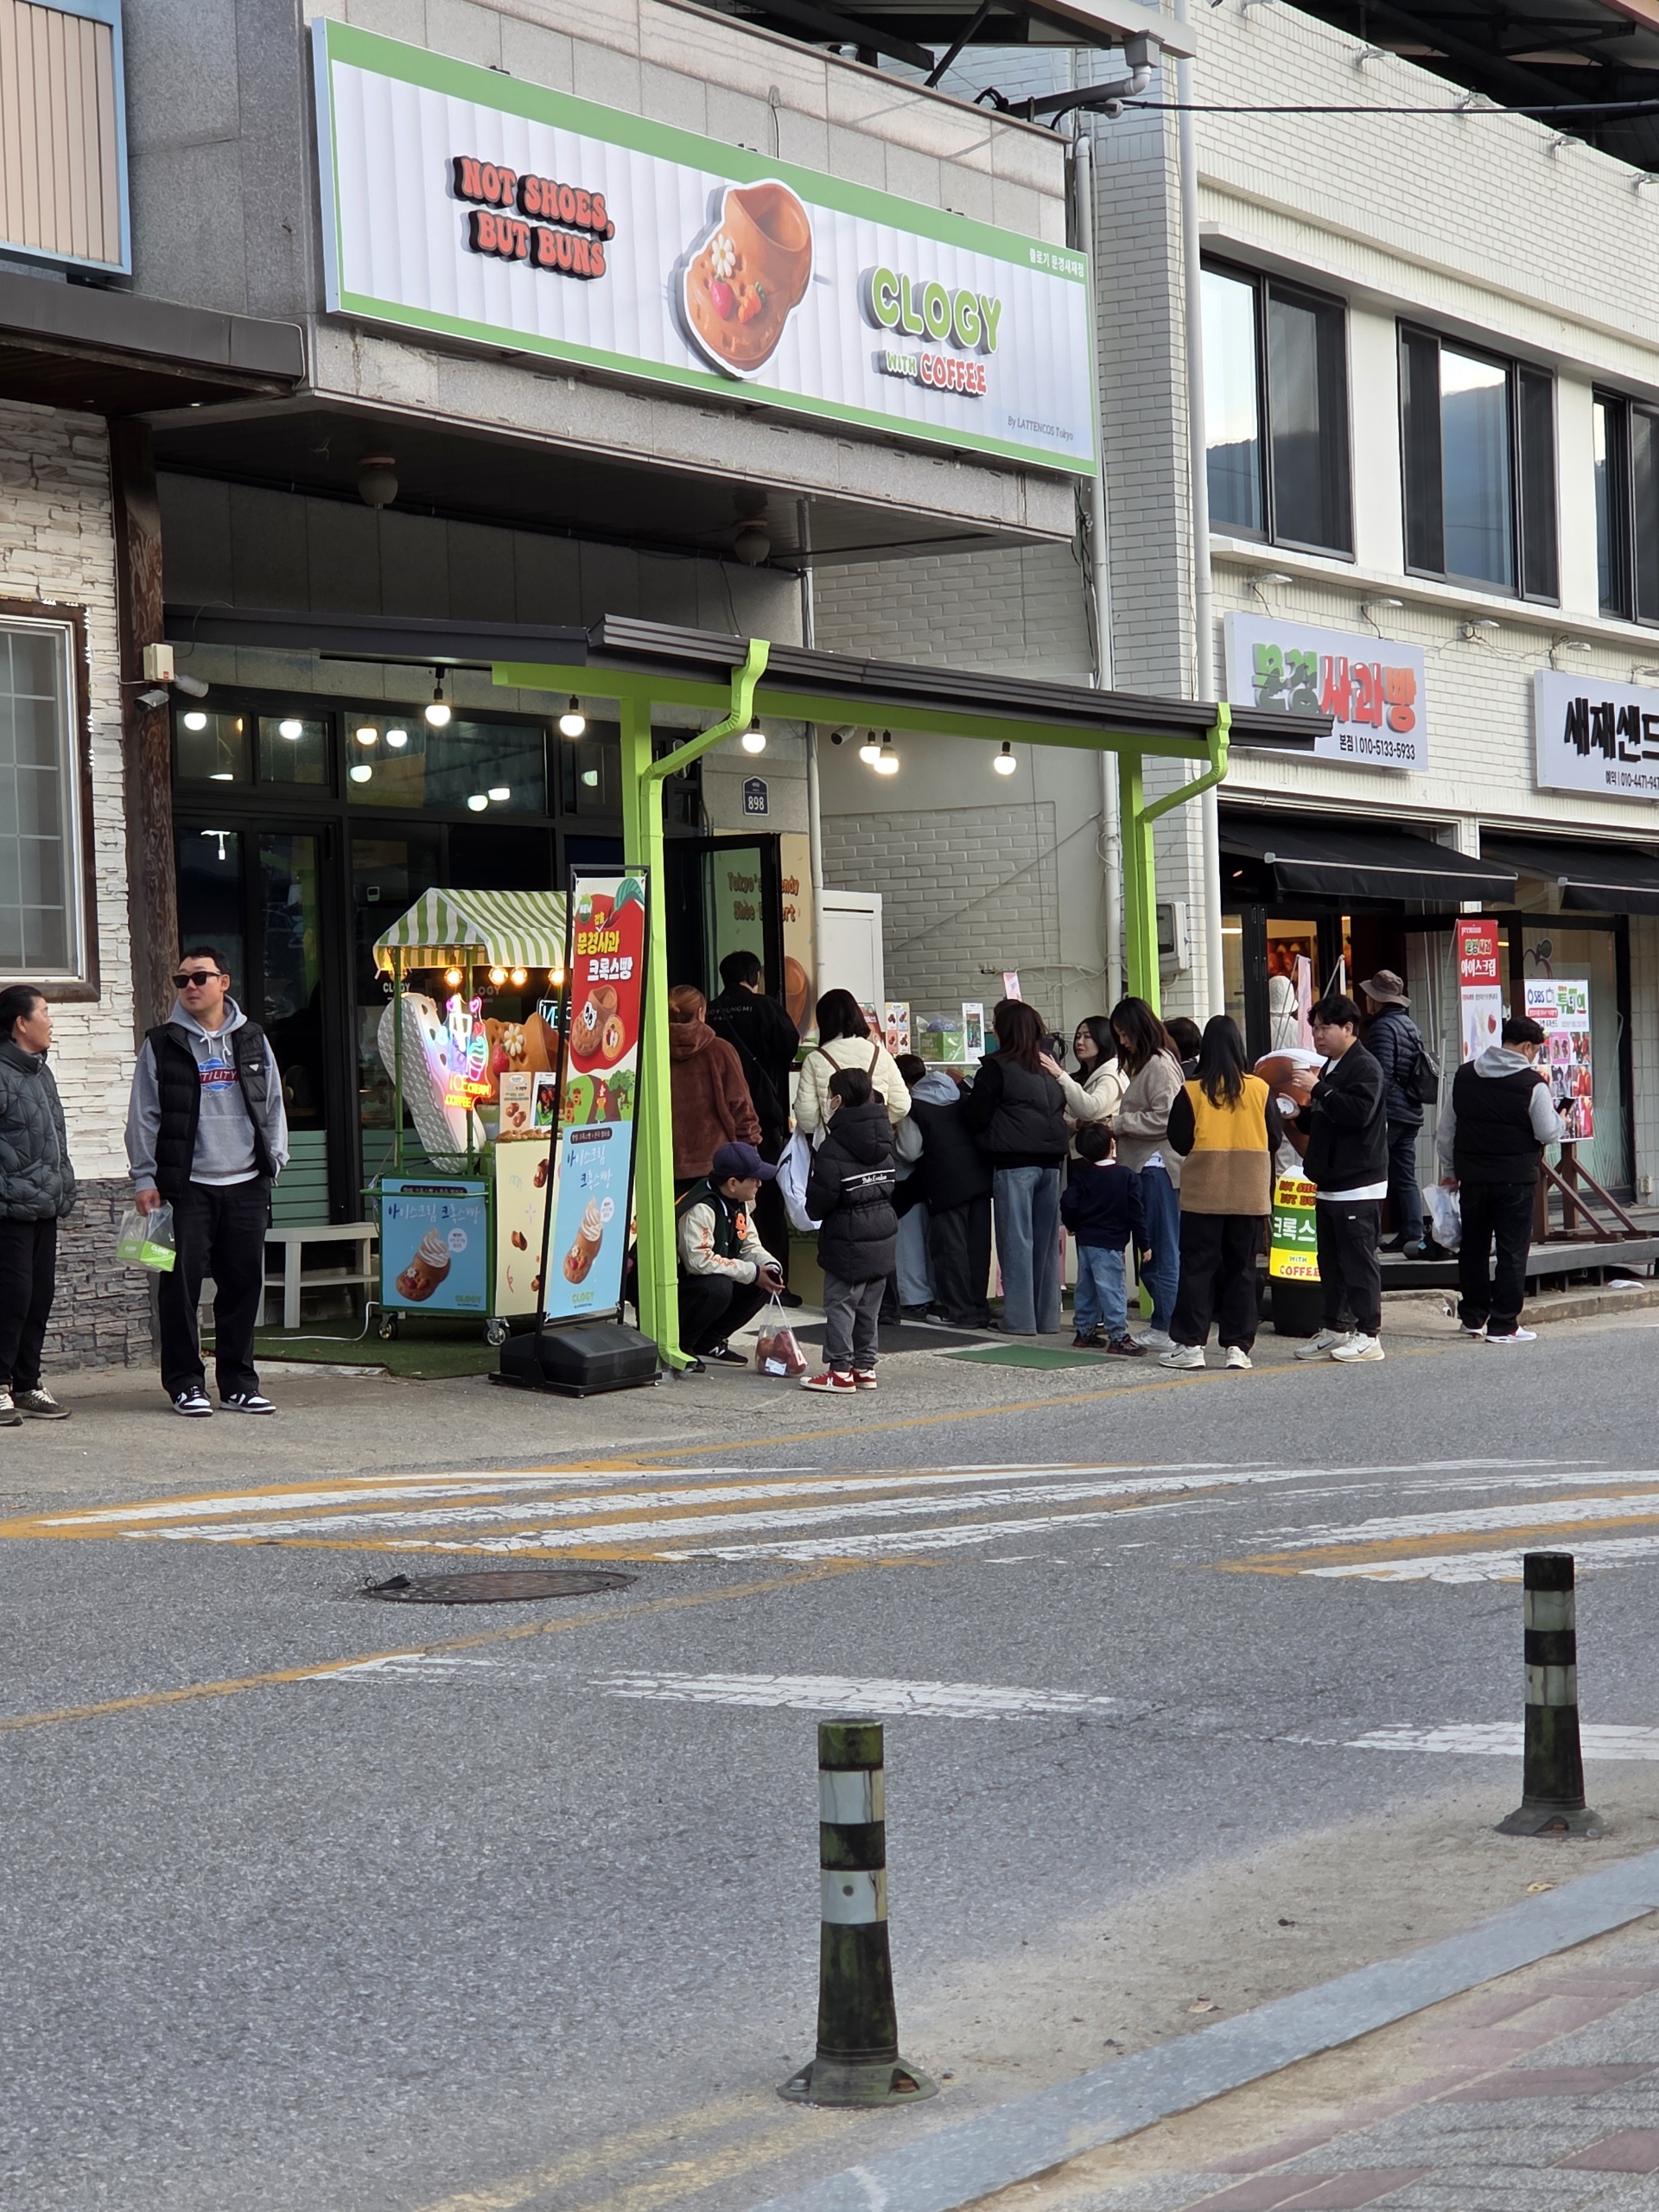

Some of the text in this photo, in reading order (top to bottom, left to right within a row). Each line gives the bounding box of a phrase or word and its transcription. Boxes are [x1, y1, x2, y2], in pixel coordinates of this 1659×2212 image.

[455, 156, 615, 240] NOT SHOES,
[471, 210, 606, 279] BUT BUNS
[1052, 255, 1084, 278] 문경새재점
[869, 266, 1002, 353] CLOGY
[885, 350, 988, 396] WITH COFFEE
[1007, 415, 1017, 429] By
[1055, 427, 1074, 442] Tokyo
[1252, 643, 1417, 733] 문경사과빵
[1339, 734, 1416, 760] 본점 010-5133-5933
[747, 796, 765, 810] 898
[734, 900, 755, 921] Shoe
[577, 931, 620, 956] 문경사과
[588, 957, 633, 982] 크록스빵
[1461, 958, 1497, 977] 아이스크림
[383, 982, 410, 993] CLGY
[200, 1071, 238, 1082] TILITY
[567, 1144, 606, 1167] 아이스크림
[581, 1168, 613, 1191] 크록스빵
[388, 1203, 481, 1224] 아이스크림 크록스빵
